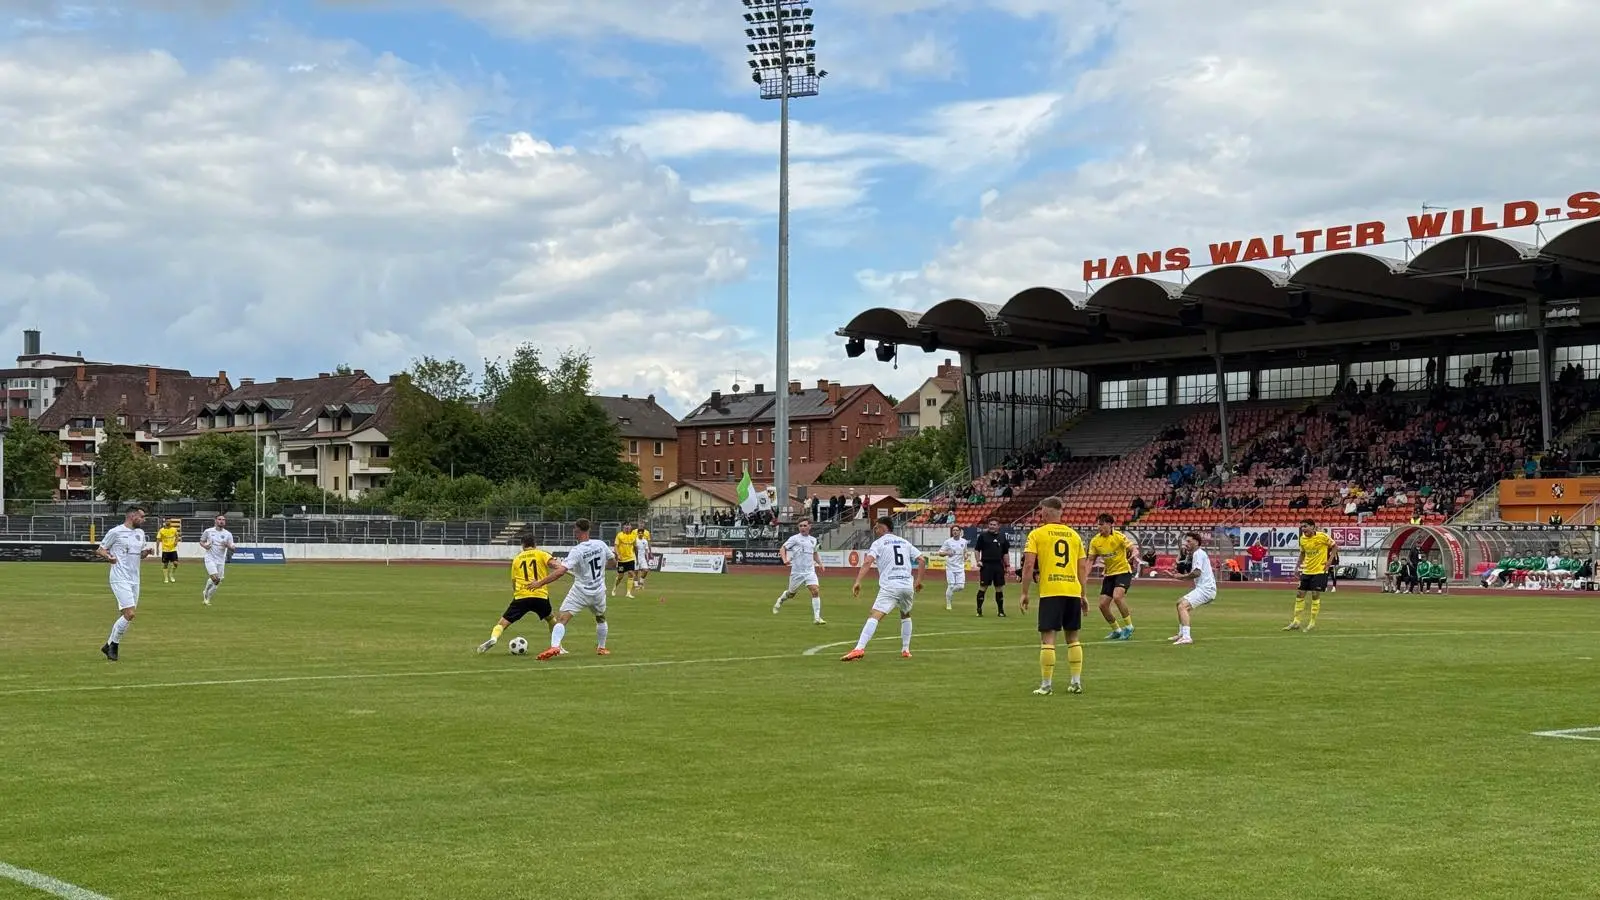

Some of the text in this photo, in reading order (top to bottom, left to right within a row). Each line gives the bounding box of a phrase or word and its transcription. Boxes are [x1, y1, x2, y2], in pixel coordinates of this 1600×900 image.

[1084, 248, 1188, 279] HANS
[1210, 222, 1383, 263] WALTER
[893, 545, 904, 565] 6
[1054, 538, 1070, 568] 9
[520, 559, 539, 581] 11
[588, 556, 602, 580] 15
